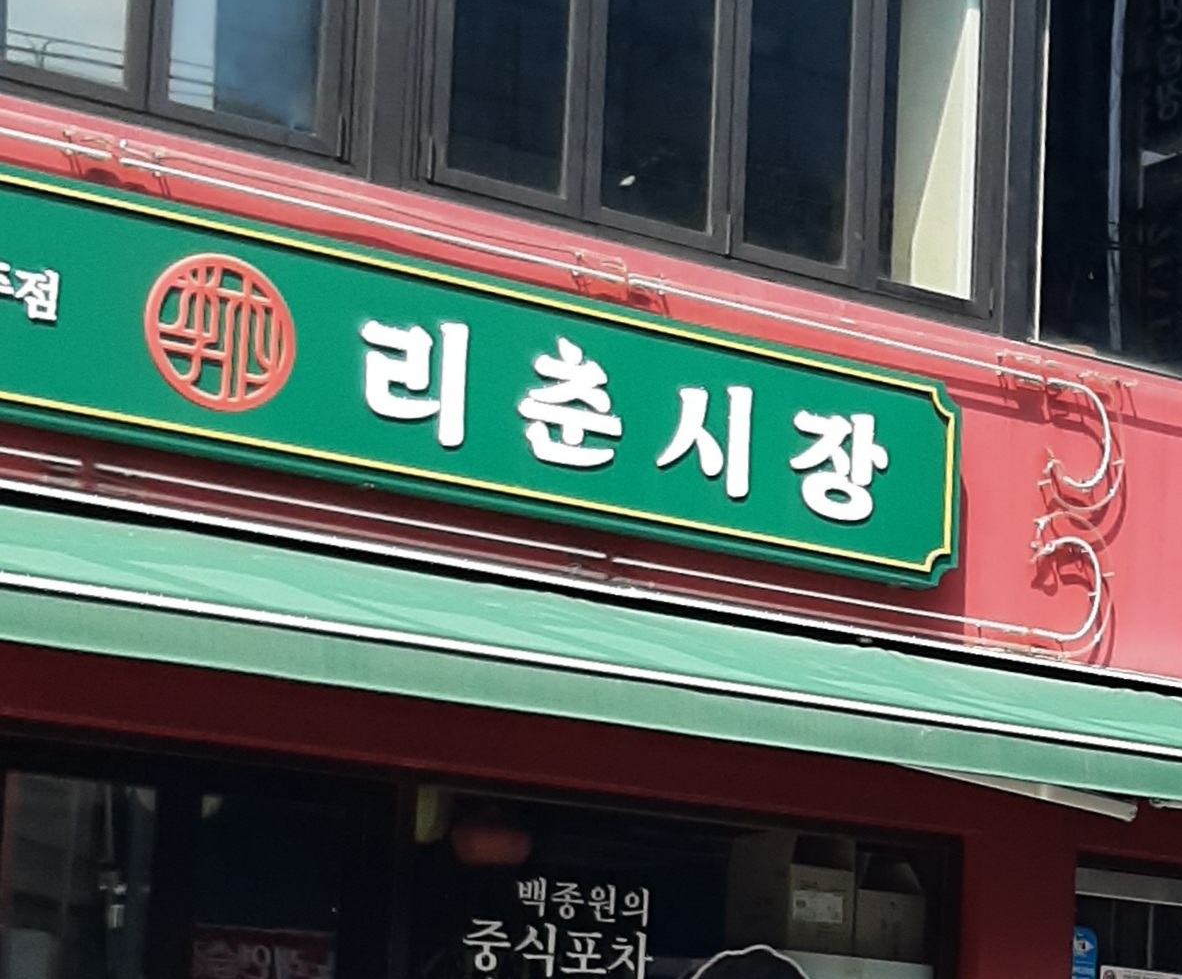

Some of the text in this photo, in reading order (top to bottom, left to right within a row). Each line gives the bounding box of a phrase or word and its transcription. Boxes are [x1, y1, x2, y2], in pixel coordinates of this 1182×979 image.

[361, 319, 890, 523] 리춘시장
[516, 876, 650, 928] 백종원의
[462, 917, 654, 979] 중식포차
